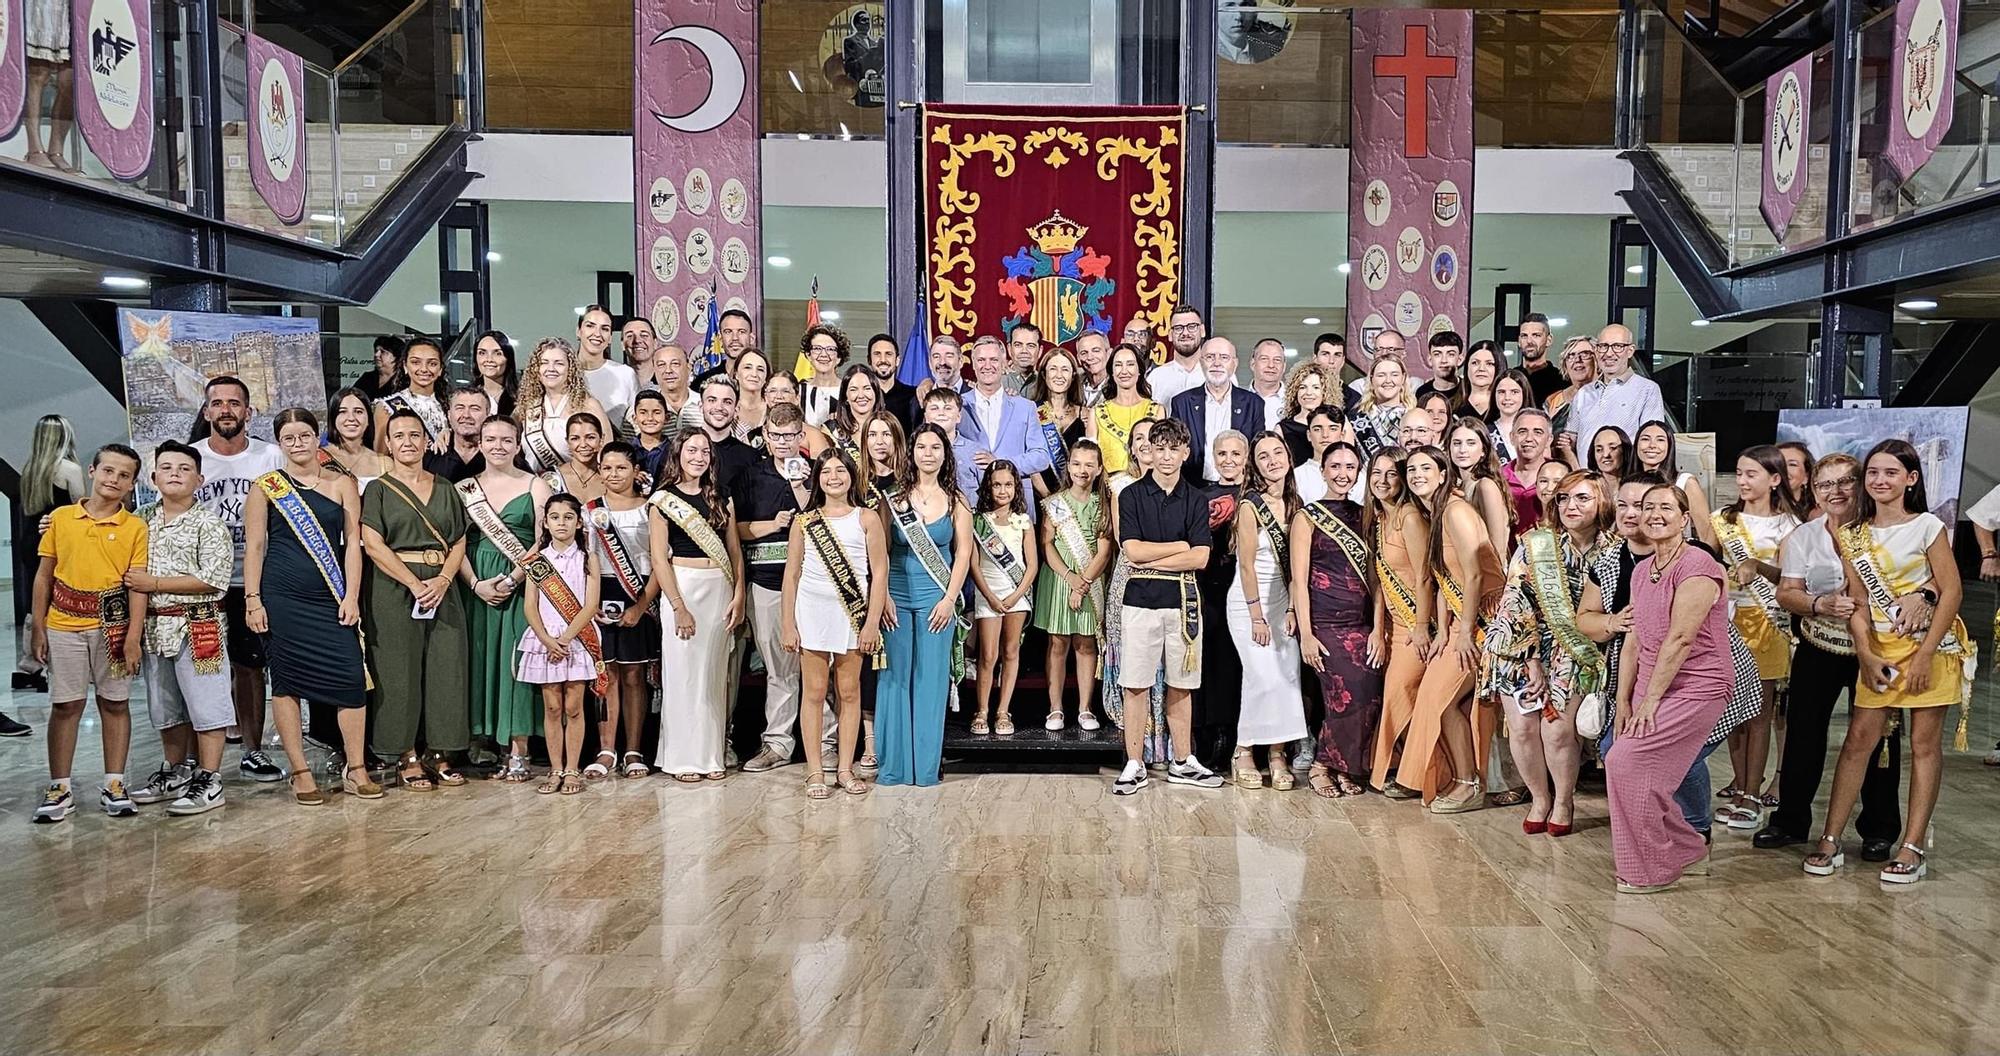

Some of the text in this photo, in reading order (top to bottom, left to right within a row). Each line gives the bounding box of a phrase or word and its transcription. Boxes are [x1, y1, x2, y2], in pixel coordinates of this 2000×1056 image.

[229, 477, 257, 495] YO
[284, 499, 335, 574] ABANDERADA
[473, 504, 521, 558] ABANDERADA
[811, 523, 851, 586] ABANDERADA
[604, 532, 643, 594] ABANDERADA
